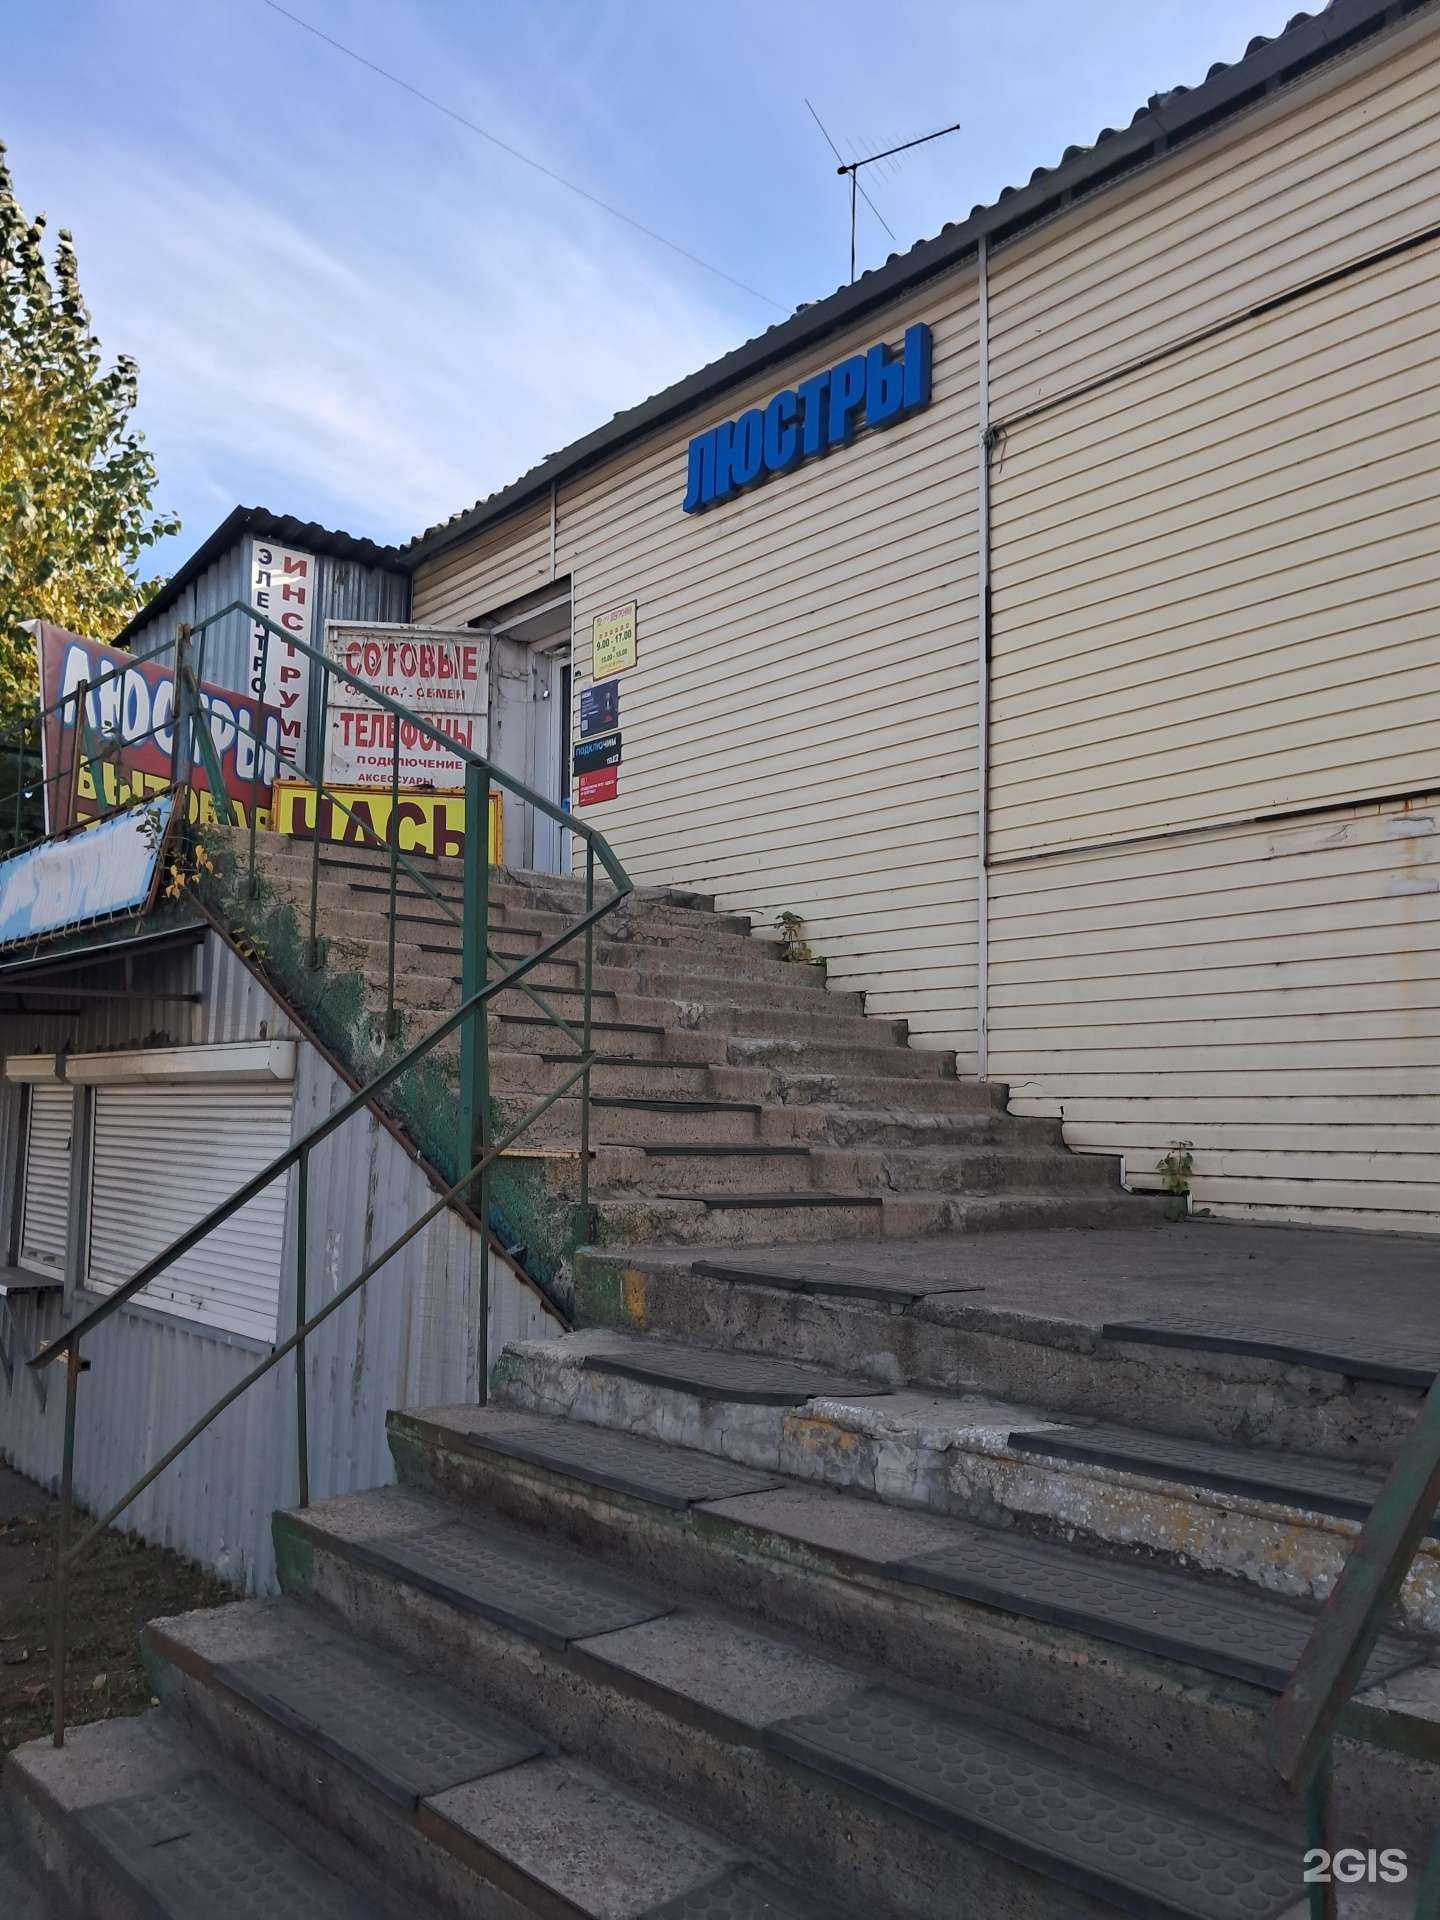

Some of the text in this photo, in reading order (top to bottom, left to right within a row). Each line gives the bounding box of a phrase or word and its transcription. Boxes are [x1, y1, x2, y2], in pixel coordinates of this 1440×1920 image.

[683, 322, 932, 514] ЛЮСТРЫ
[277, 556, 308, 781] ИНСТРУМЕ
[345, 641, 478, 680] СОТОВЫЕ
[356, 755, 464, 770] ПОДКЛЮЧЕНИЕ
